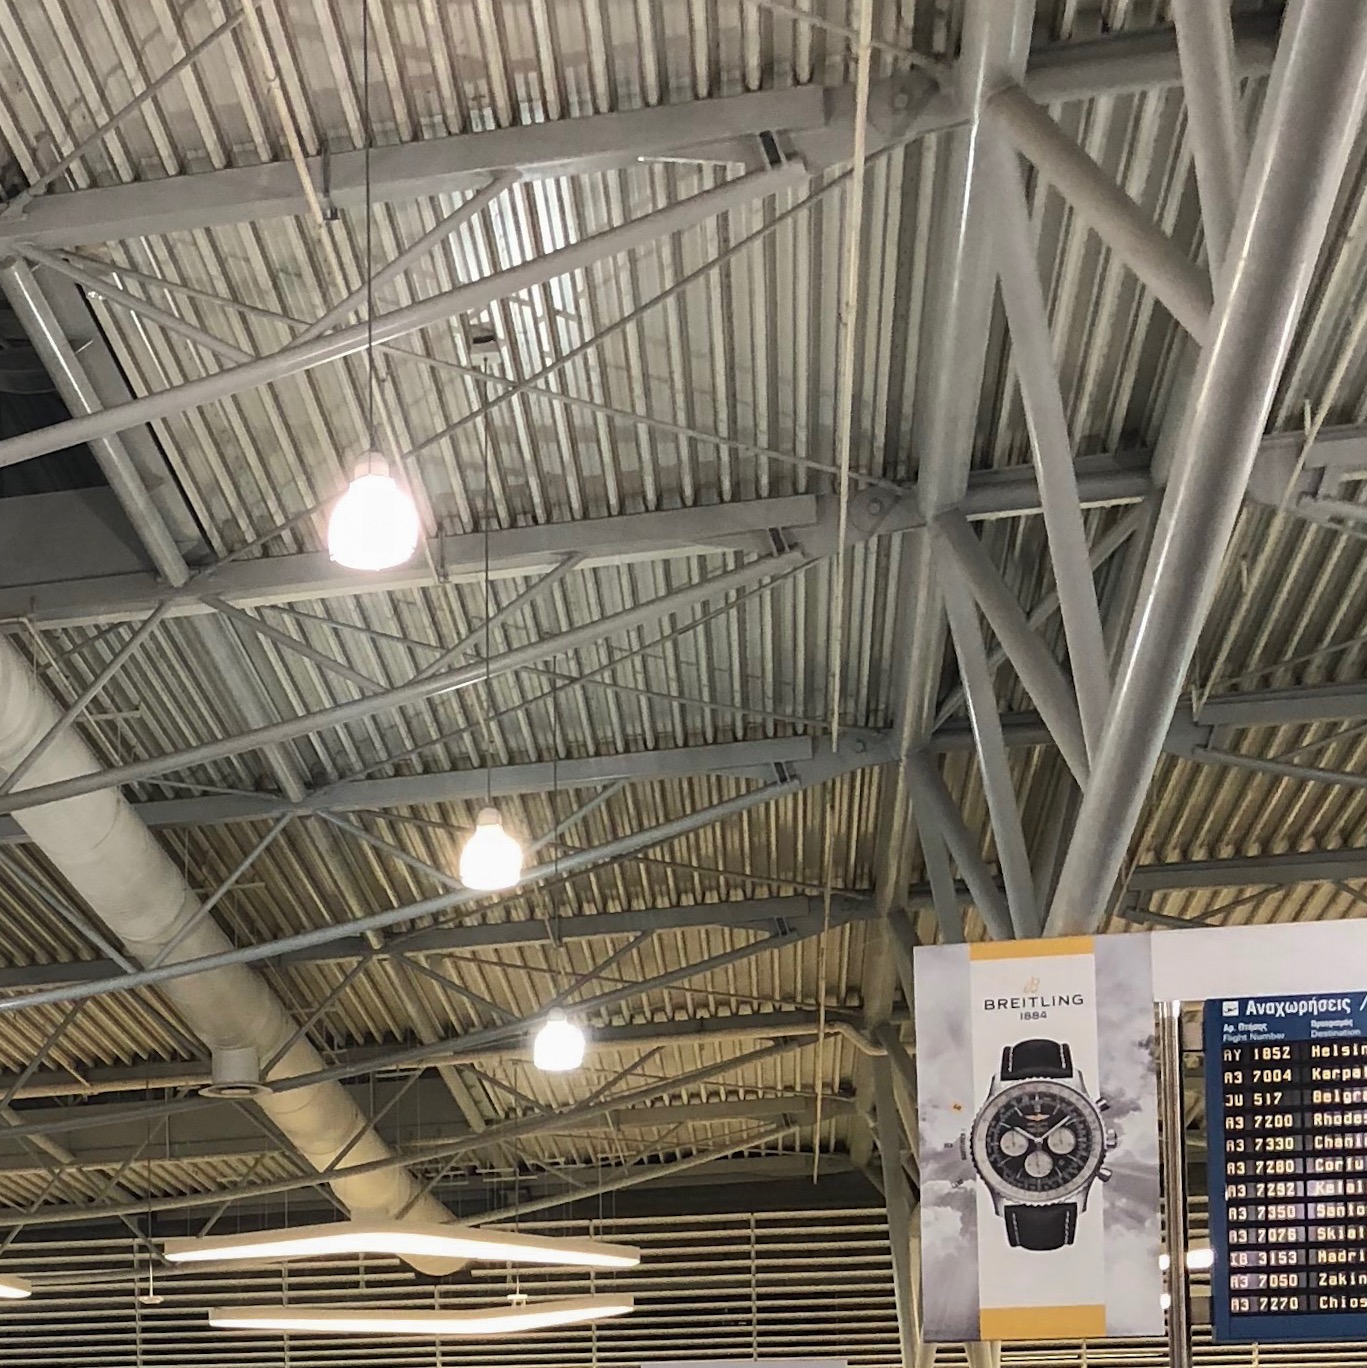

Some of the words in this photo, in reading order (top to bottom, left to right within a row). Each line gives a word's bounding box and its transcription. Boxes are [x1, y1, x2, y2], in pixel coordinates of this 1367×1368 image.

[984, 994, 1084, 1011] BREITLING
[1245, 997, 1351, 1017] Αναχωρήσεις
[1020, 1011, 1048, 1021] 1884
[1223, 1033, 1248, 1043] Flight
[1250, 1032, 1285, 1041] Number
[1310, 1029, 1361, 1038] Destination
[1223, 1048, 1242, 1061] AY
[1254, 1046, 1292, 1061] 1852
[1224, 1071, 1243, 1085] A3
[1253, 1068, 1292, 1083] 7004
[1225, 1094, 1244, 1107] JU
[1253, 1091, 1283, 1106] 517
[1225, 1116, 1245, 1129] A3
[1254, 1113, 1294, 1129] 7200
[1226, 1138, 1245, 1152] A3
[1255, 1136, 1294, 1151] 7330
[1227, 1161, 1246, 1175] A3
[1315, 1157, 1365, 1172] Corfu
[1228, 1184, 1247, 1198] A3
[1257, 1182, 1295, 1197] 7292
[1229, 1207, 1247, 1221] A3
[1257, 1205, 1296, 1220] 7350
[1229, 1229, 1247, 1244] A3
[1258, 1251, 1297, 1266] 3153
[1230, 1275, 1249, 1289] A3
[1258, 1273, 1298, 1288] 7050
[1231, 1297, 1250, 1312] A3
[1259, 1295, 1299, 1311] 7270
